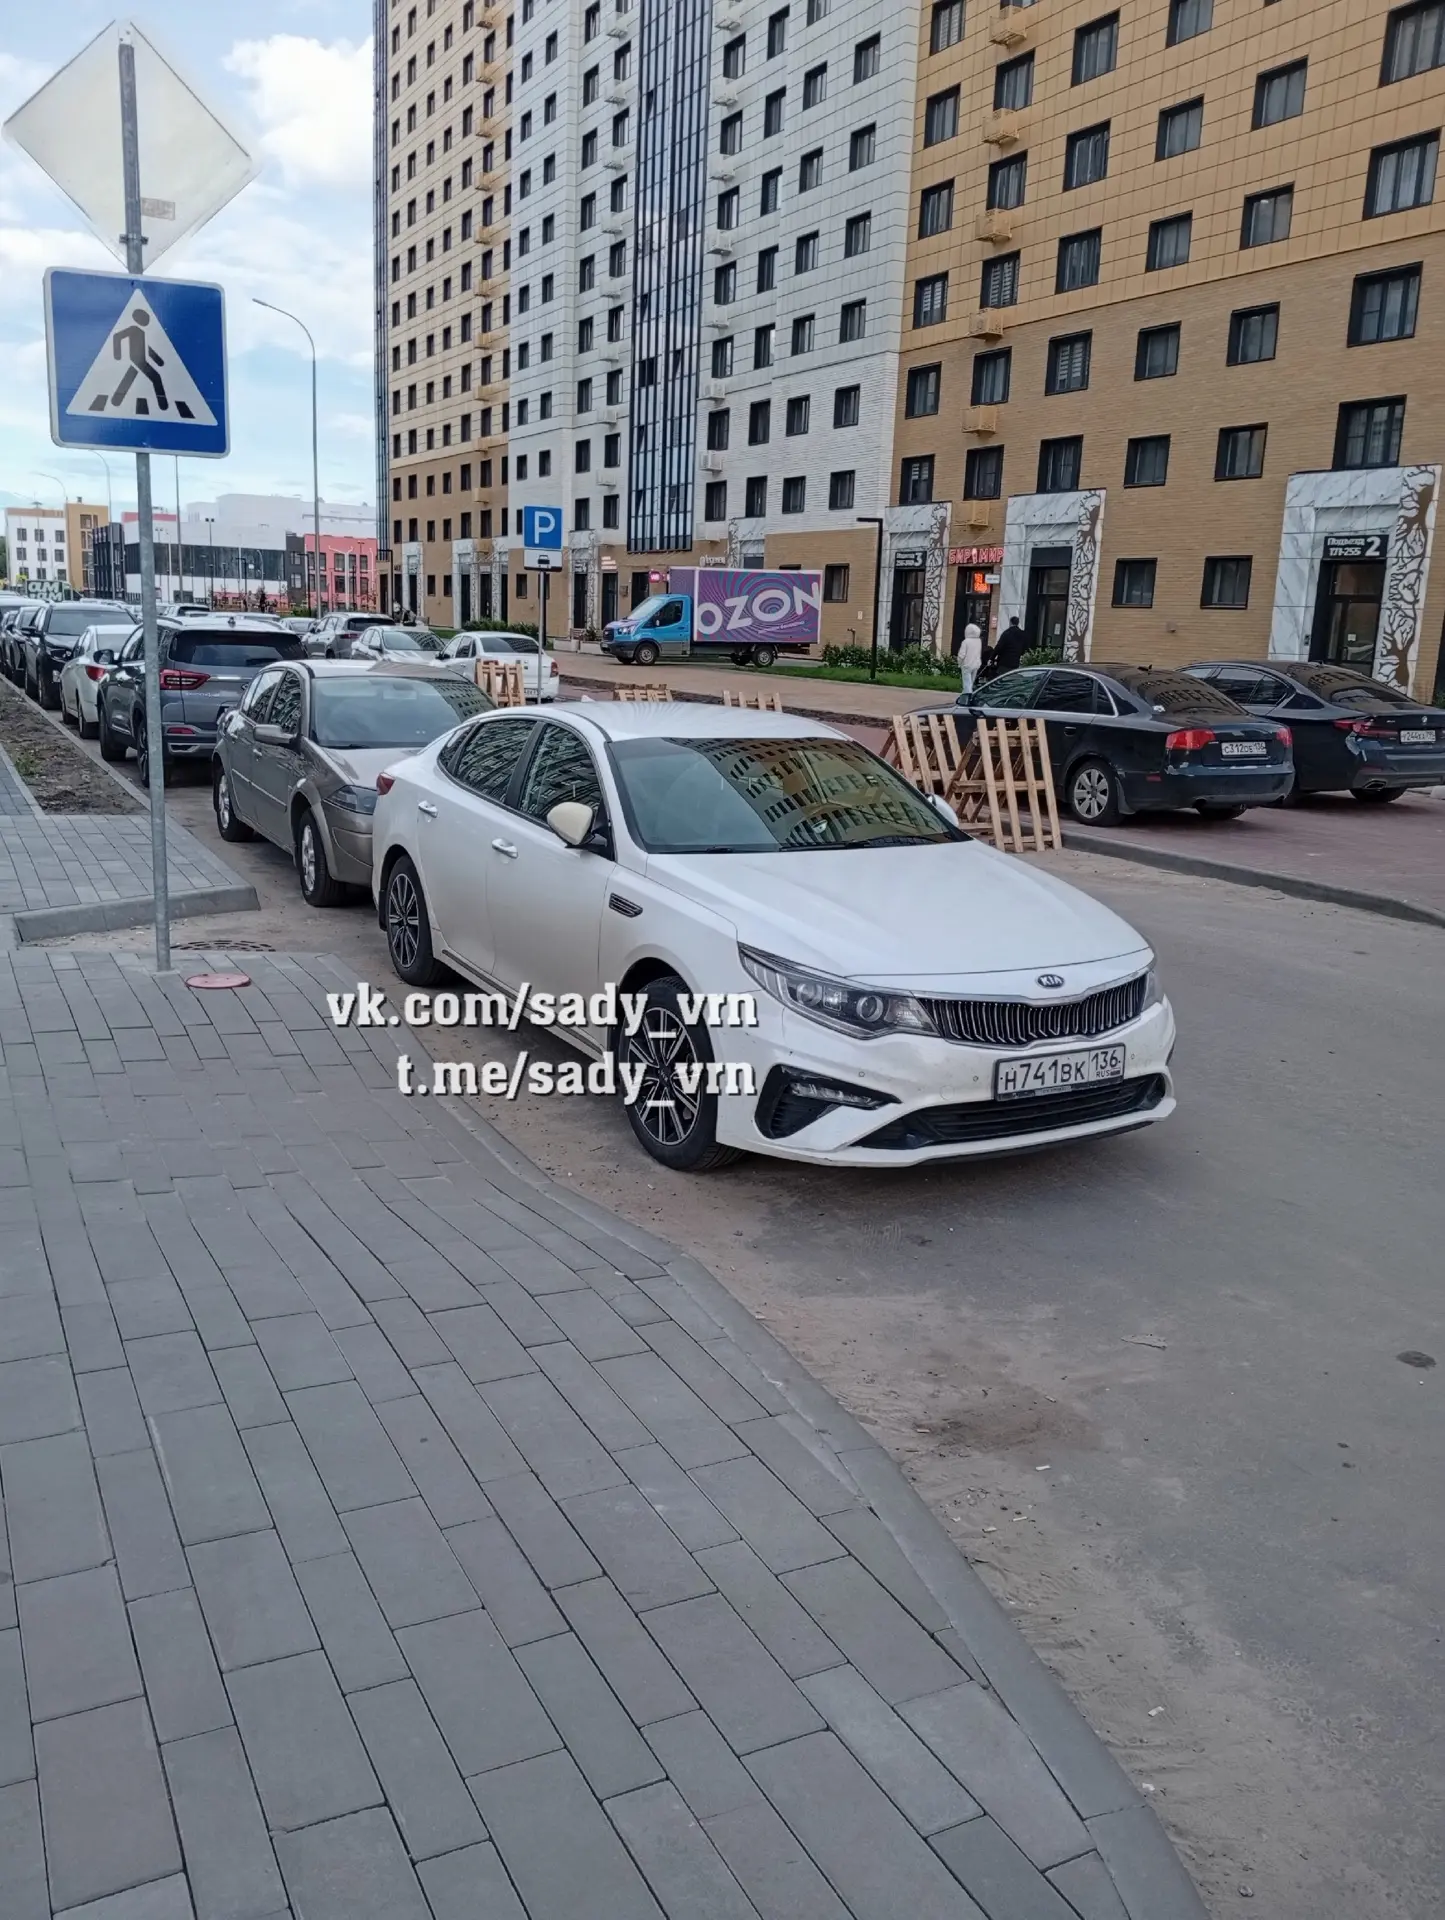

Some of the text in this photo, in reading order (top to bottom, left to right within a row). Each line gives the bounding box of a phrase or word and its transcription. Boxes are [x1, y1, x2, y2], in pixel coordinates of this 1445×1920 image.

[534, 510, 556, 545] P
[1329, 547, 1361, 556] 171-255
[1364, 536, 1381, 557] 2
[914, 552, 923, 567] 3
[697, 582, 820, 635] OZON
[1040, 975, 1063, 987] KIA
[1004, 1049, 1119, 1092] Н741ВК 136
[1095, 1069, 1111, 1078] RUS
